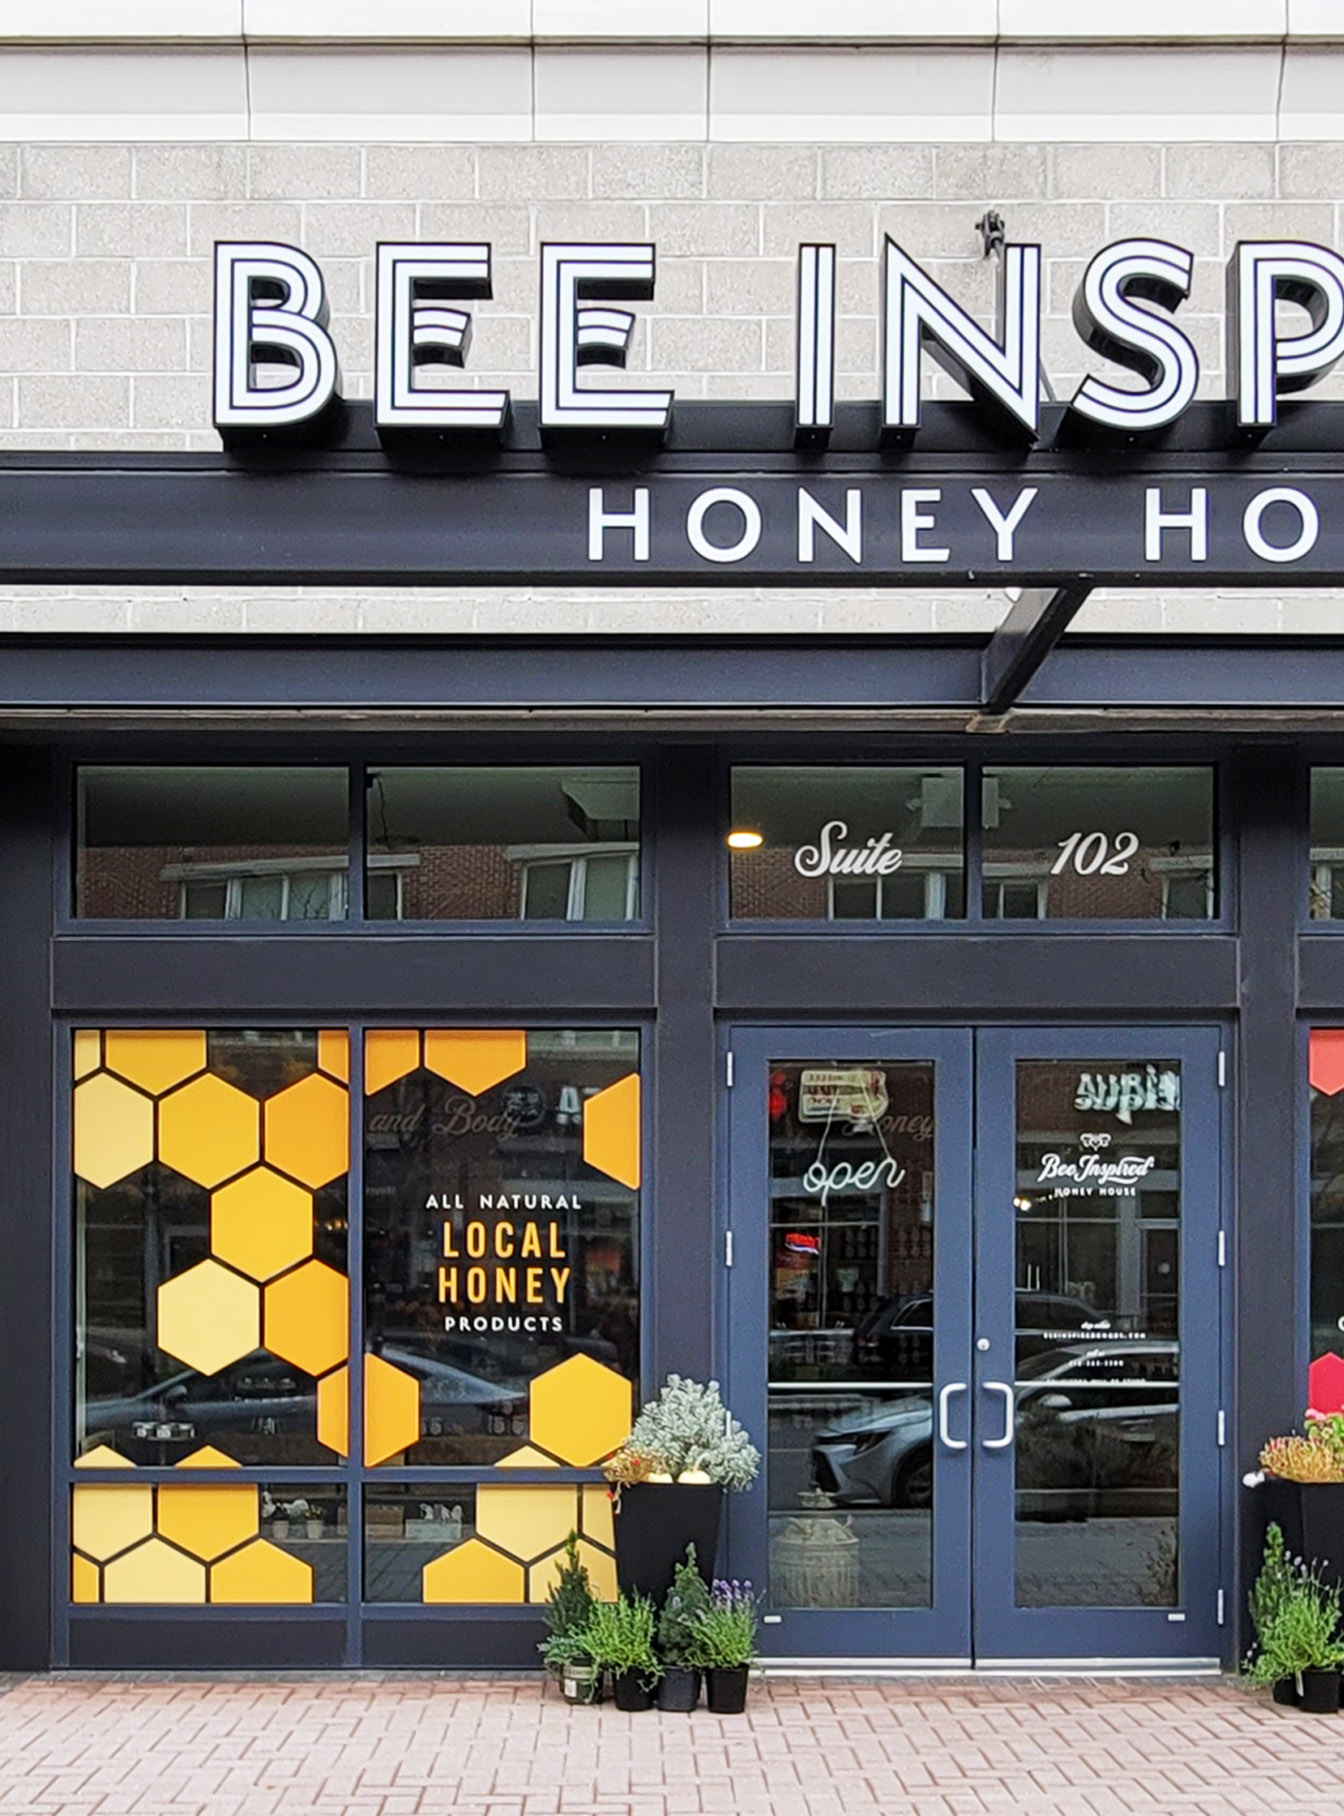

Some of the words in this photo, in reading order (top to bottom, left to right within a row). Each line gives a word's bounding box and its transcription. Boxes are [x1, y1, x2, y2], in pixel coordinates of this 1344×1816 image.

[212, 240, 675, 432] BEE
[587, 487, 1039, 564] HONEY
[793, 820, 904, 878] Suite
[1049, 831, 1140, 876] 102
[803, 1157, 905, 1207] open
[1073, 1153, 1156, 1185] Inspired
[425, 1194, 464, 1210] ALL
[479, 1194, 582, 1210] NATURAL
[1054, 1187, 1094, 1197] HONEY
[1098, 1187, 1137, 1197] HOUSE
[442, 1221, 566, 1259] LOCAL
[438, 1266, 571, 1304] HONEY
[444, 1316, 563, 1332] PRODUCTS
